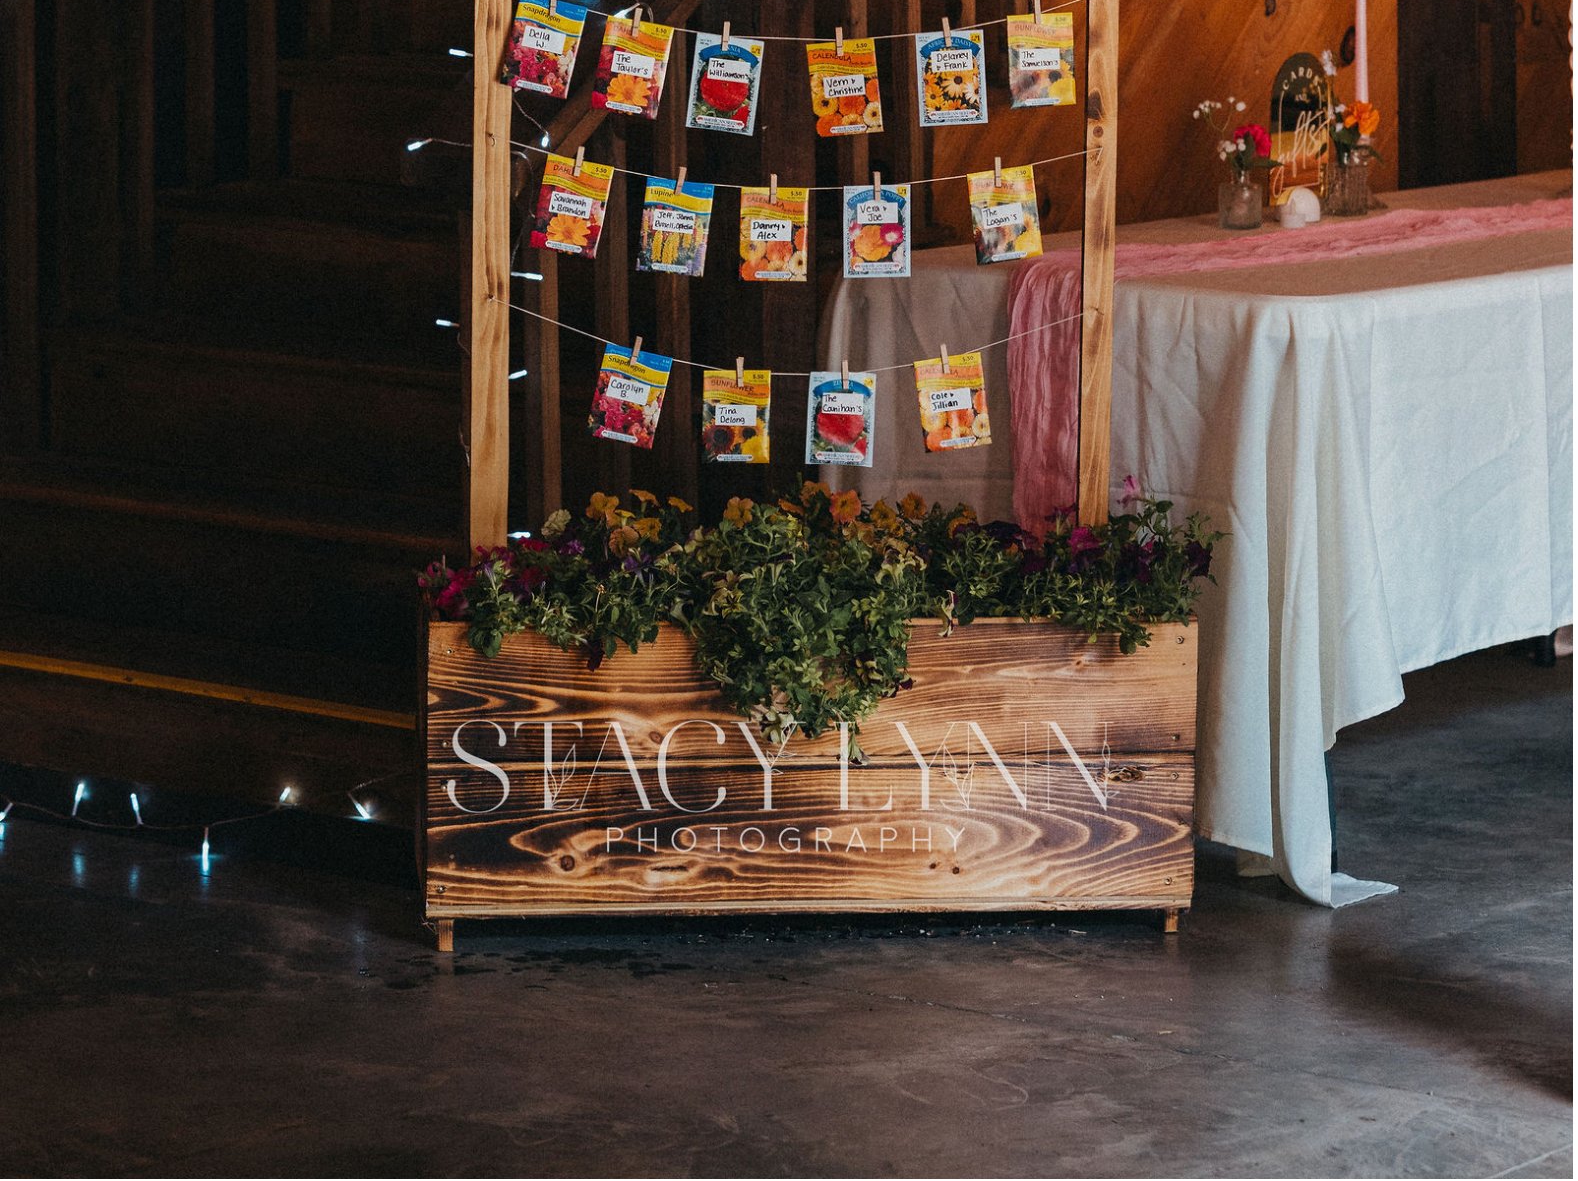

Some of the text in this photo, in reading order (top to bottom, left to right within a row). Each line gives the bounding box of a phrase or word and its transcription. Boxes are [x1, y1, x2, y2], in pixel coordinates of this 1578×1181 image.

[523, 4, 560, 23] Snapdragon
[528, 29, 550, 41] Della
[616, 53, 631, 63] The
[937, 52, 969, 62] Delaney
[1022, 51, 1034, 59] The
[711, 60, 725, 68] The
[944, 61, 968, 70] Frank
[616, 63, 648, 75] Taylor's
[826, 79, 848, 87] Vern
[828, 86, 863, 97] Christine
[650, 189, 673, 197] Lupine
[554, 194, 587, 207] Savannah
[860, 205, 880, 213] Vera
[983, 209, 997, 217] The
[867, 213, 883, 222] Joe
[986, 214, 1017, 226] Logan's
[752, 221, 780, 231] Danny
[757, 231, 778, 239] Alex
[608, 356, 646, 374] Snapdagon
[611, 379, 644, 394] Carolyn
[823, 394, 837, 402] The
[931, 392, 948, 400] Cole
[719, 407, 737, 415] Tina
